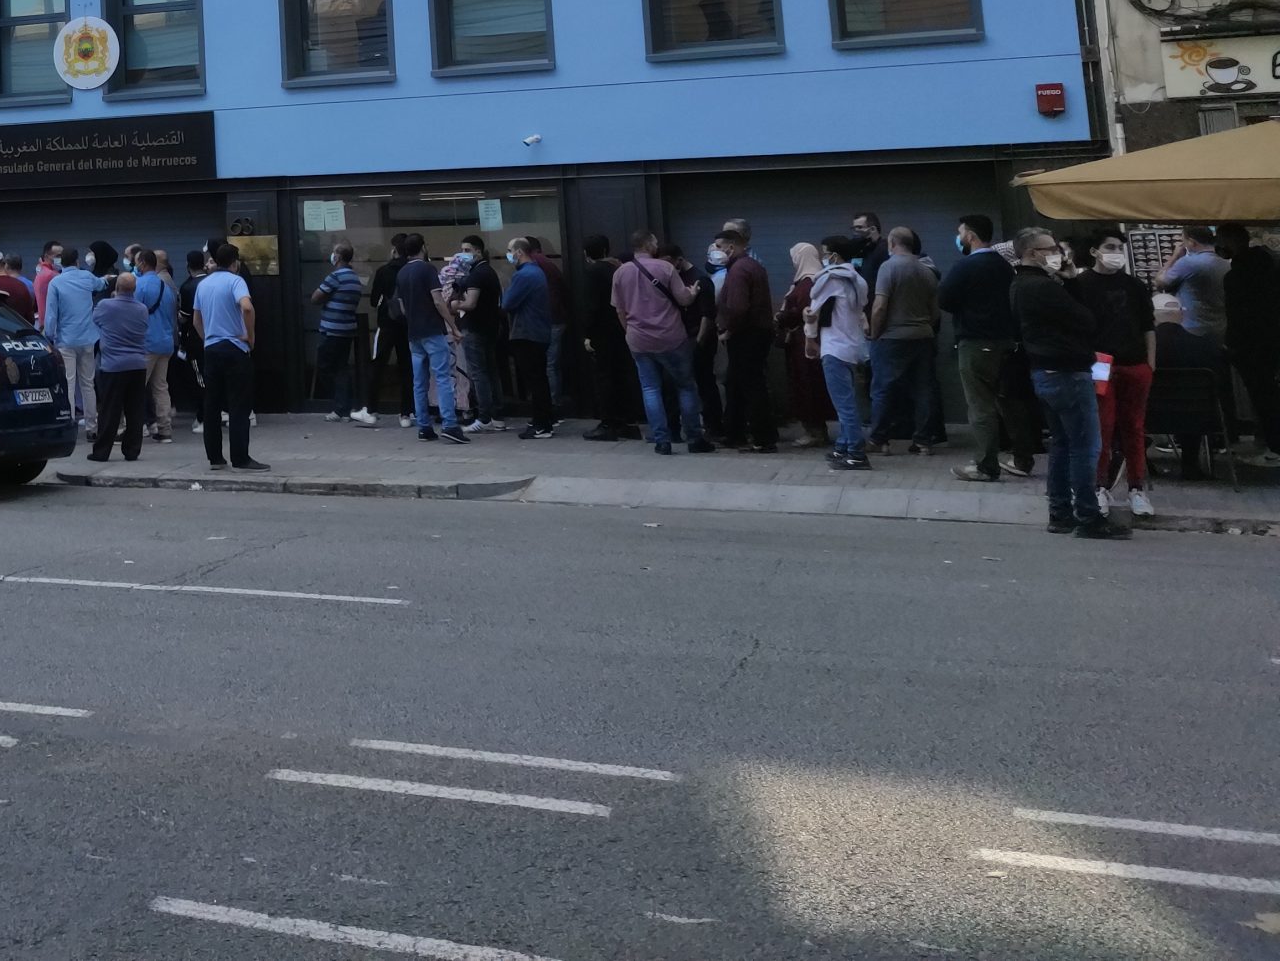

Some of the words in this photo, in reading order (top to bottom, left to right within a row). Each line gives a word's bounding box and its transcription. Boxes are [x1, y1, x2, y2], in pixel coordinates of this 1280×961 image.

[46, 136, 88, 151] للمملكة
[92, 133, 127, 148] العامة
[37, 160, 76, 172] General
[78, 158, 93, 170] del
[96, 157, 124, 169] Reino
[127, 156, 139, 168] de
[142, 155, 198, 167] Marruecos
[230, 217, 252, 235] 63
